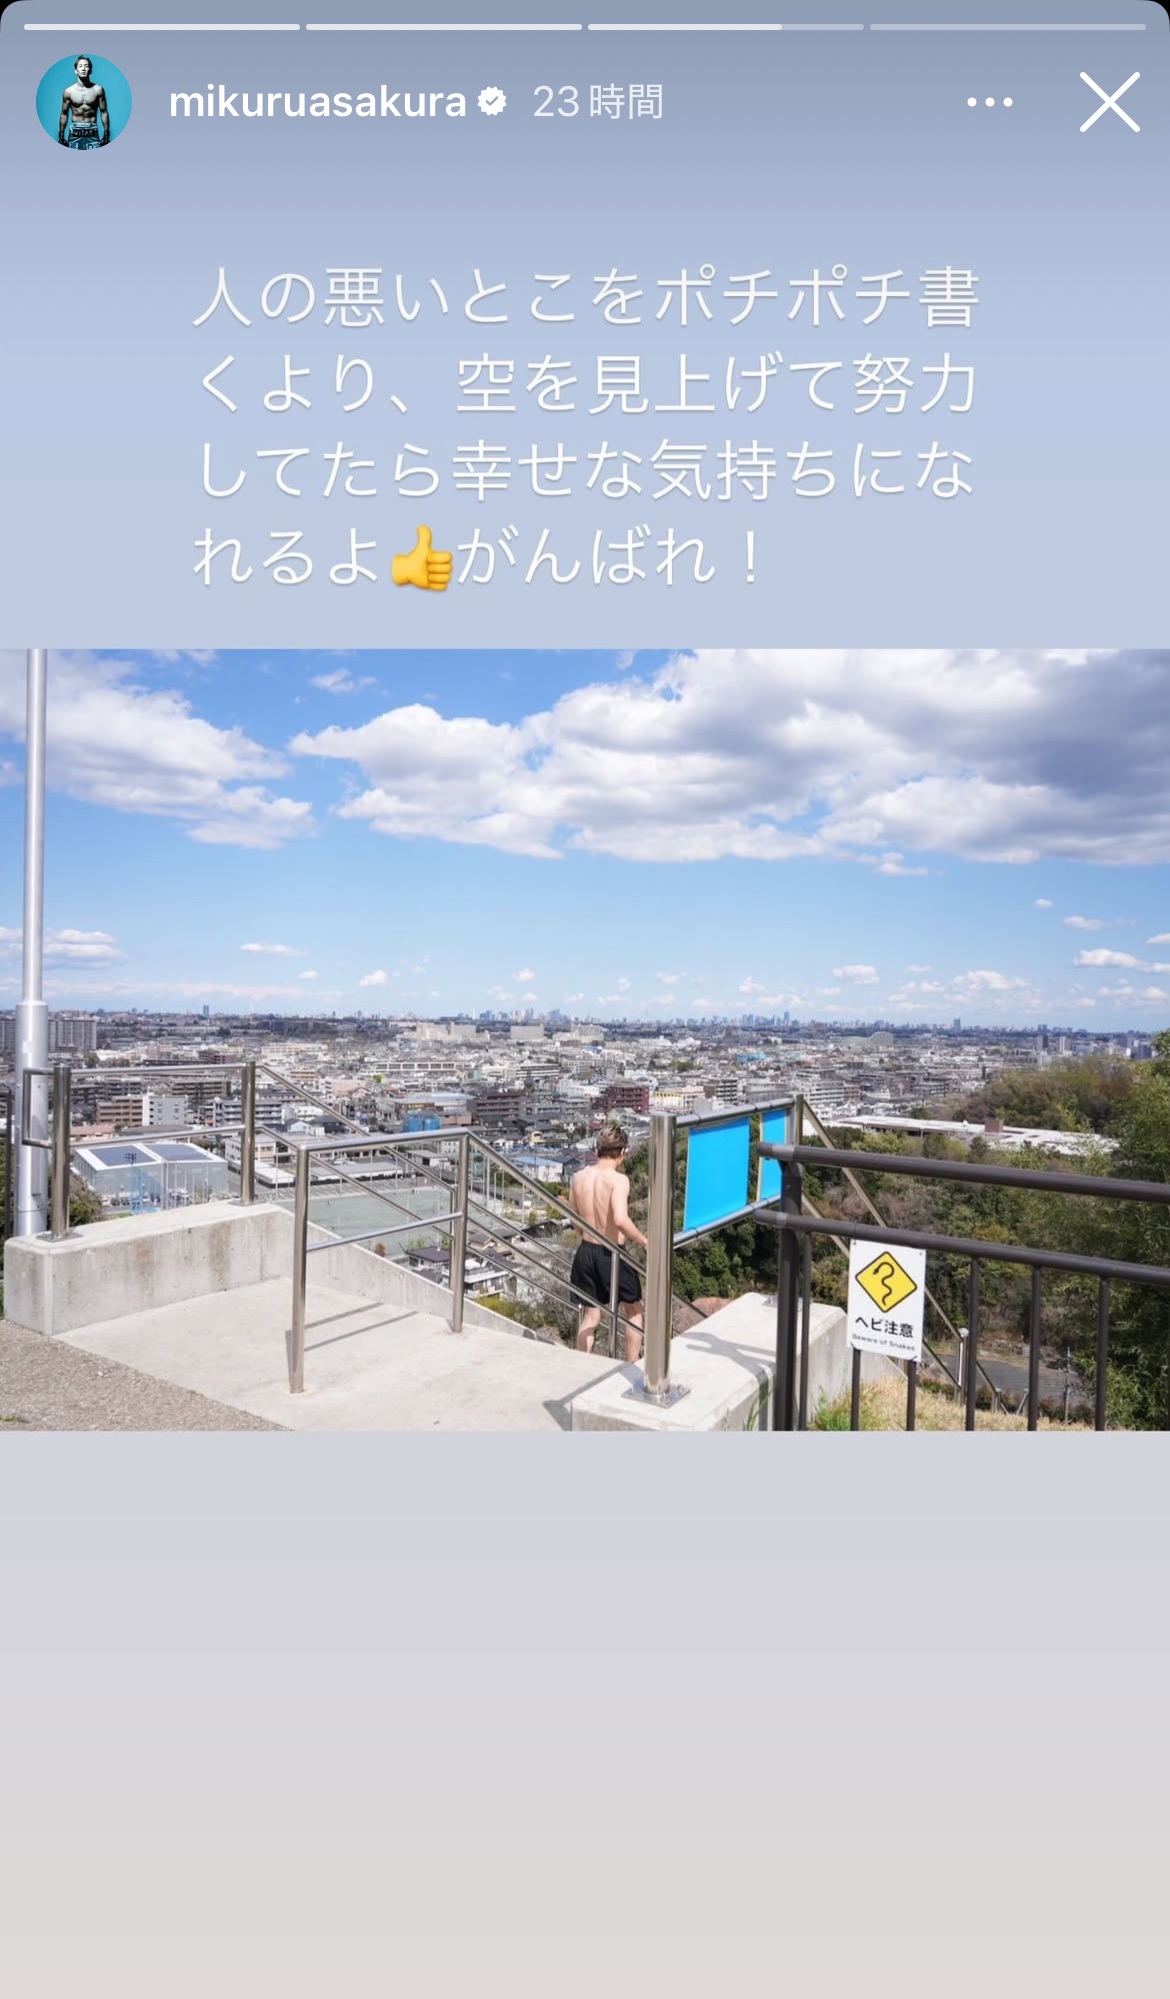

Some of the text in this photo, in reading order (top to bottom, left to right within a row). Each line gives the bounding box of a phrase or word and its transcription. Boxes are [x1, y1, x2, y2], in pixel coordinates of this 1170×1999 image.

[855, 1316, 914, 1339] ヘビ注意
[852, 1333, 878, 1344] Beware
[889, 1340, 916, 1352] Snakes
